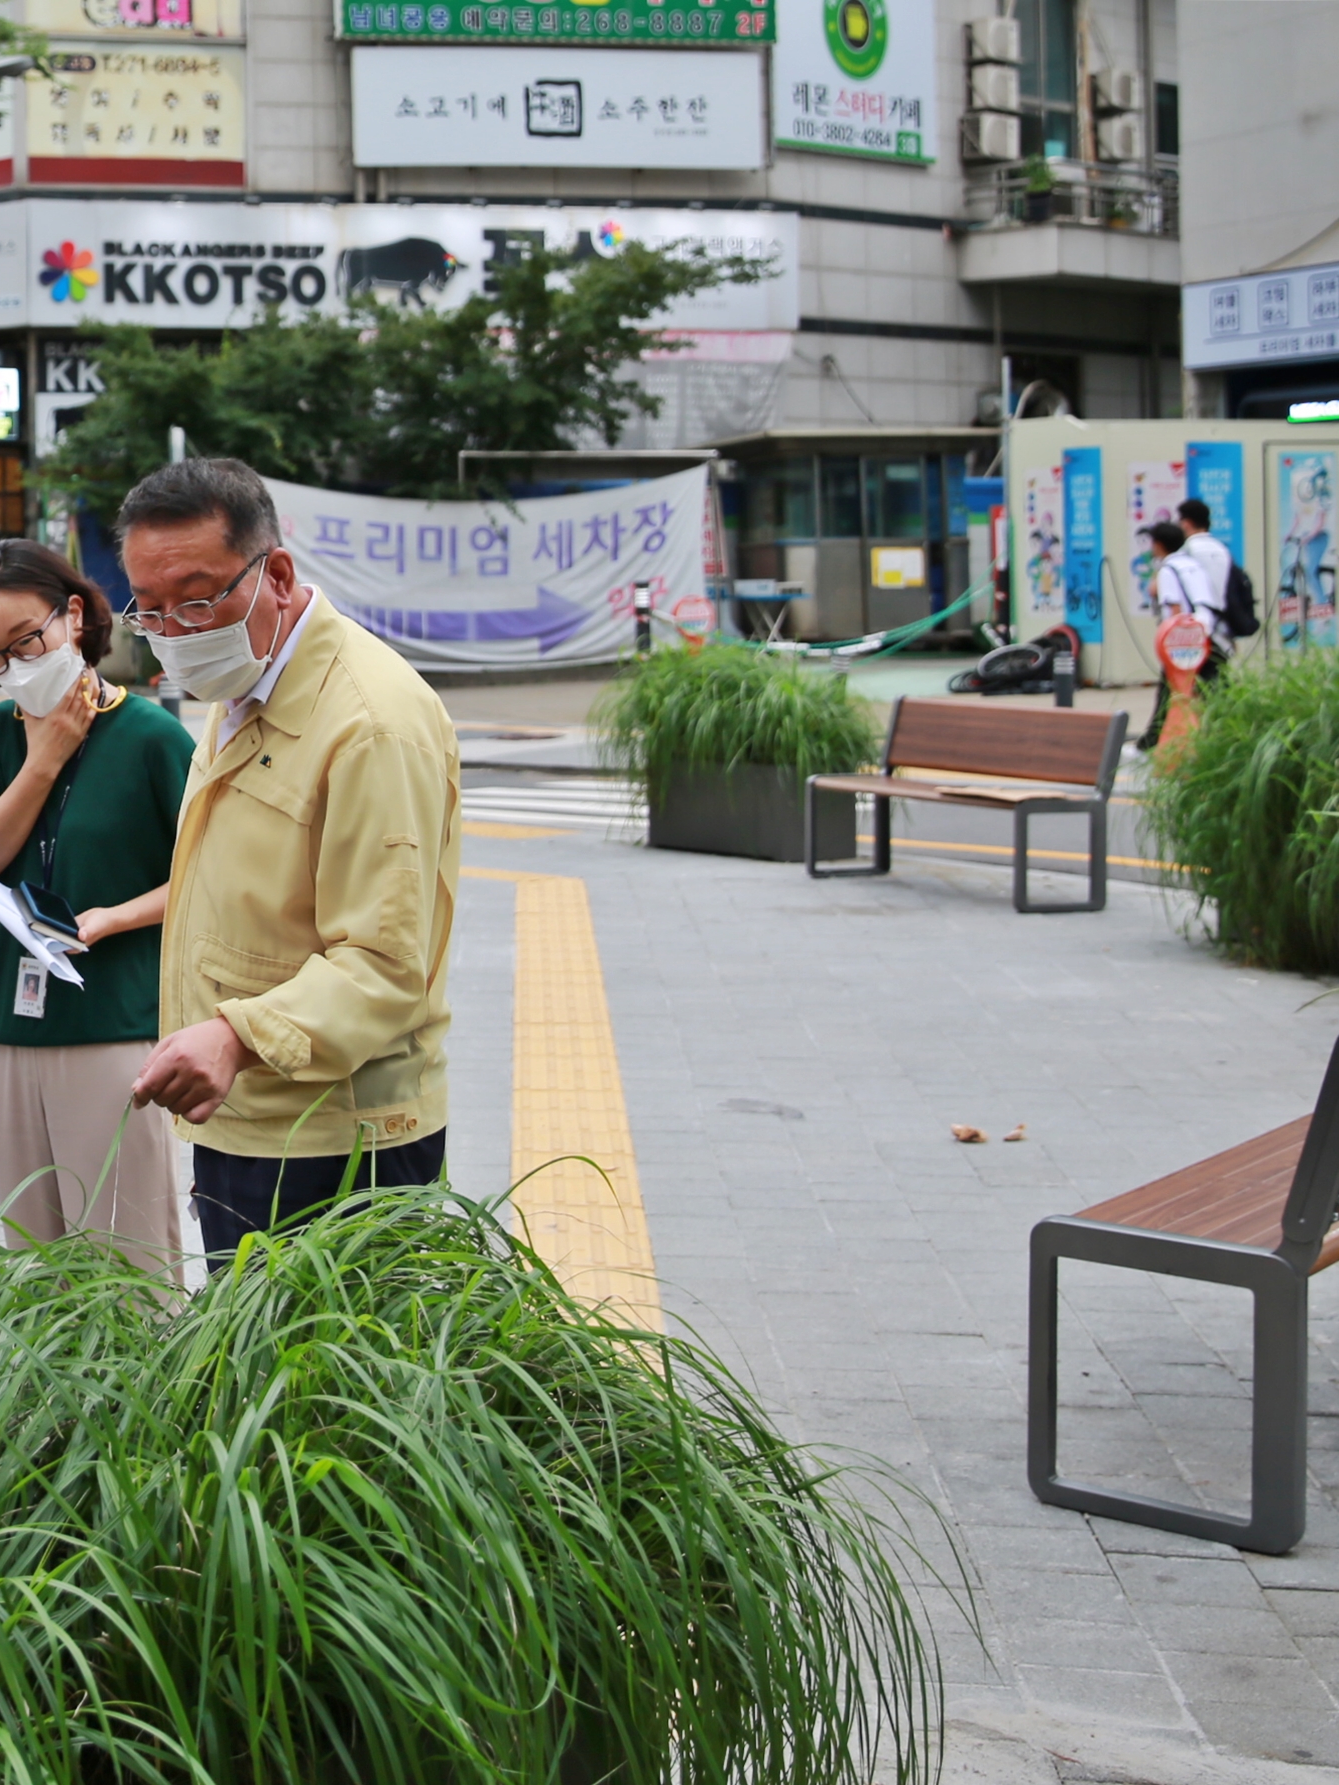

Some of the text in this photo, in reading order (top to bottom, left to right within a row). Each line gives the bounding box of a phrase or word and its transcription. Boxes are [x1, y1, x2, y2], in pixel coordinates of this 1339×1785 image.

[348, 6, 451, 31] 남녀공용
[735, 12, 769, 36] 2F
[834, 87, 886, 124] 스터디
[889, 97, 921, 130] 카페
[103, 241, 180, 258] BLACK
[103, 262, 327, 306] KKOTSO
[310, 514, 510, 577] 프리미엄
[532, 500, 675, 571] 세차장
